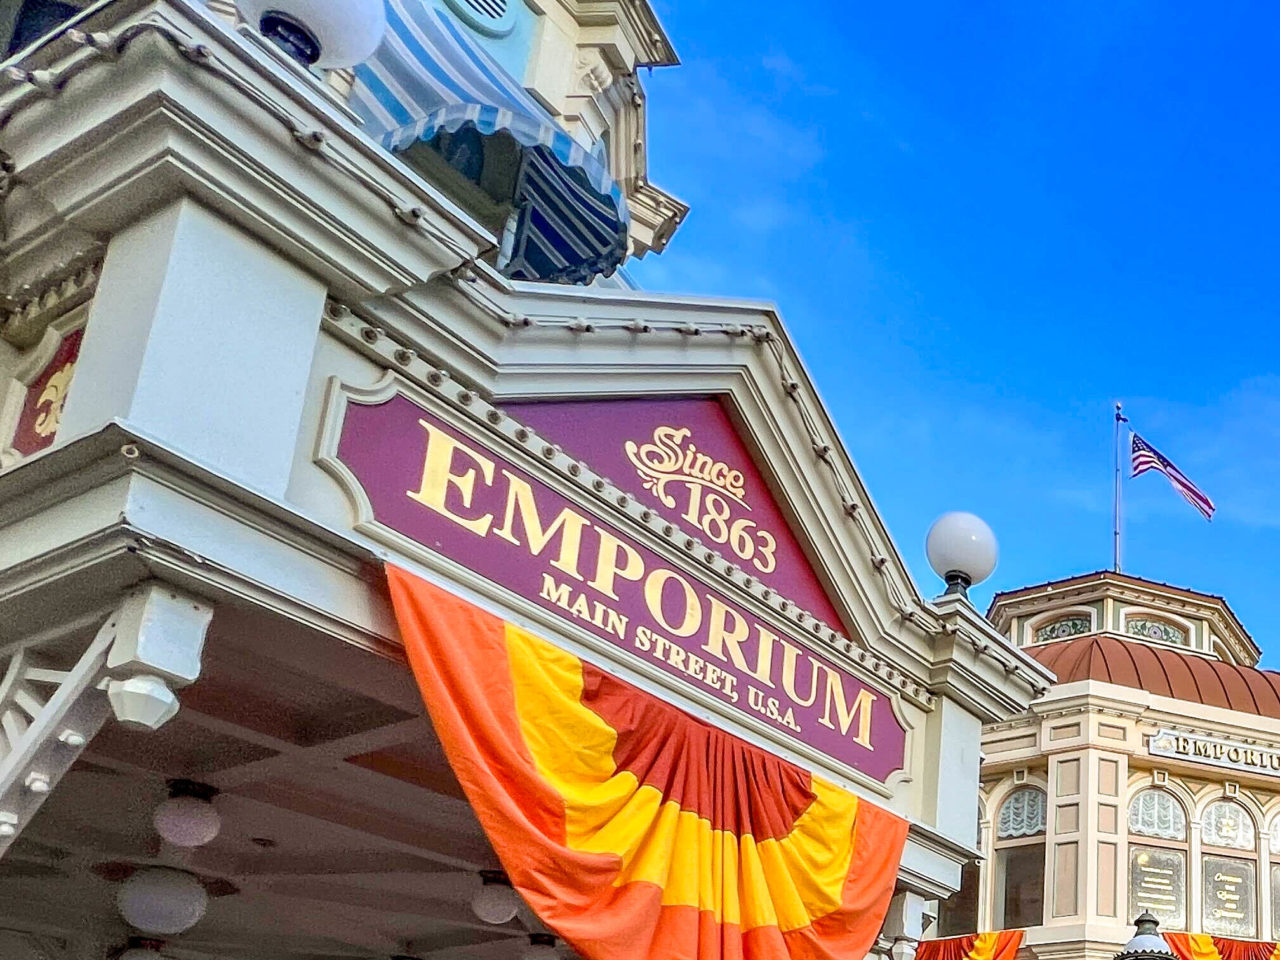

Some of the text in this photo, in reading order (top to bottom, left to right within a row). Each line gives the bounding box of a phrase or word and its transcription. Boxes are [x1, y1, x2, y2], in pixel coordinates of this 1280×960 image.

[632, 426, 747, 499] Since
[406, 418, 876, 751] EMPORIUM
[681, 483, 776, 573] 1863
[539, 572, 801, 733] MAIN STREET, U.S.A.
